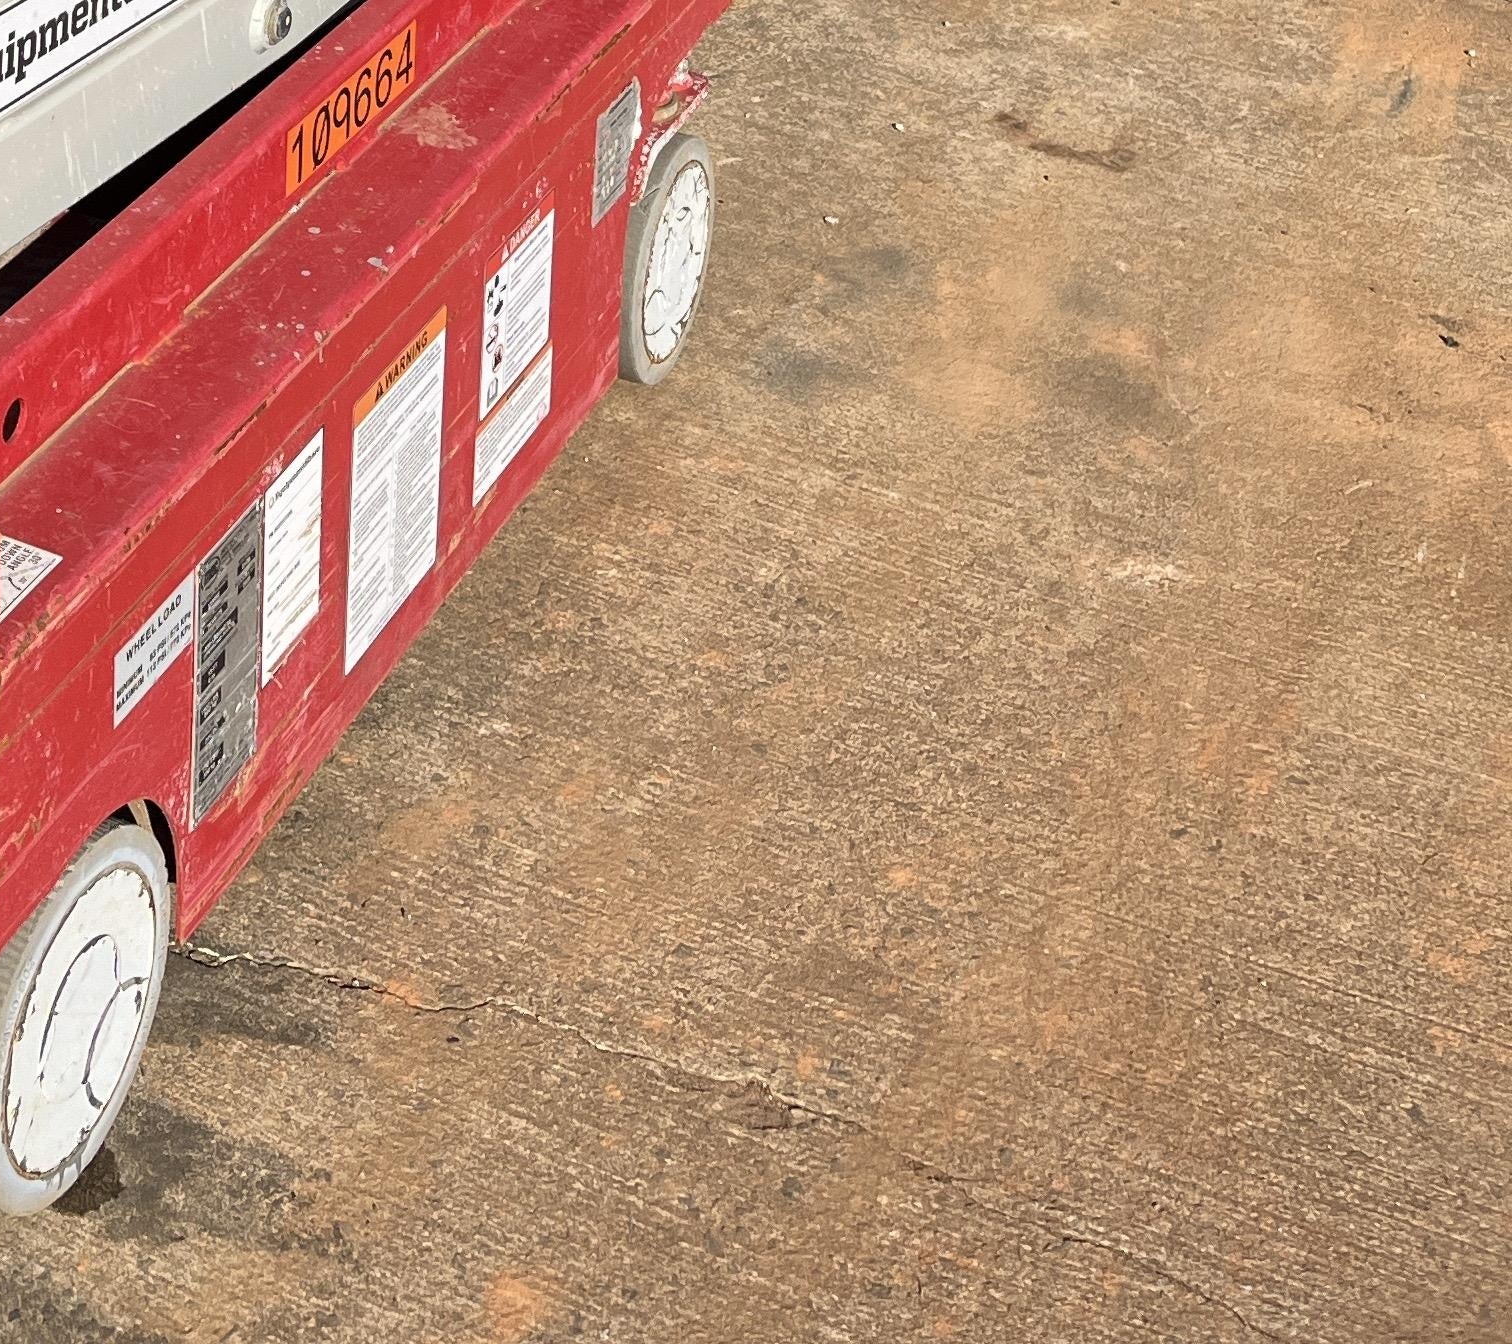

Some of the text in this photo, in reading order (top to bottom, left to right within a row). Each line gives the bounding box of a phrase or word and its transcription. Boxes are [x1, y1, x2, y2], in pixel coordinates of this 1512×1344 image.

[292, 29, 413, 184] 109664
[385, 331, 428, 389] WARNING
[126, 593, 182, 662] WHEEL LOAD
